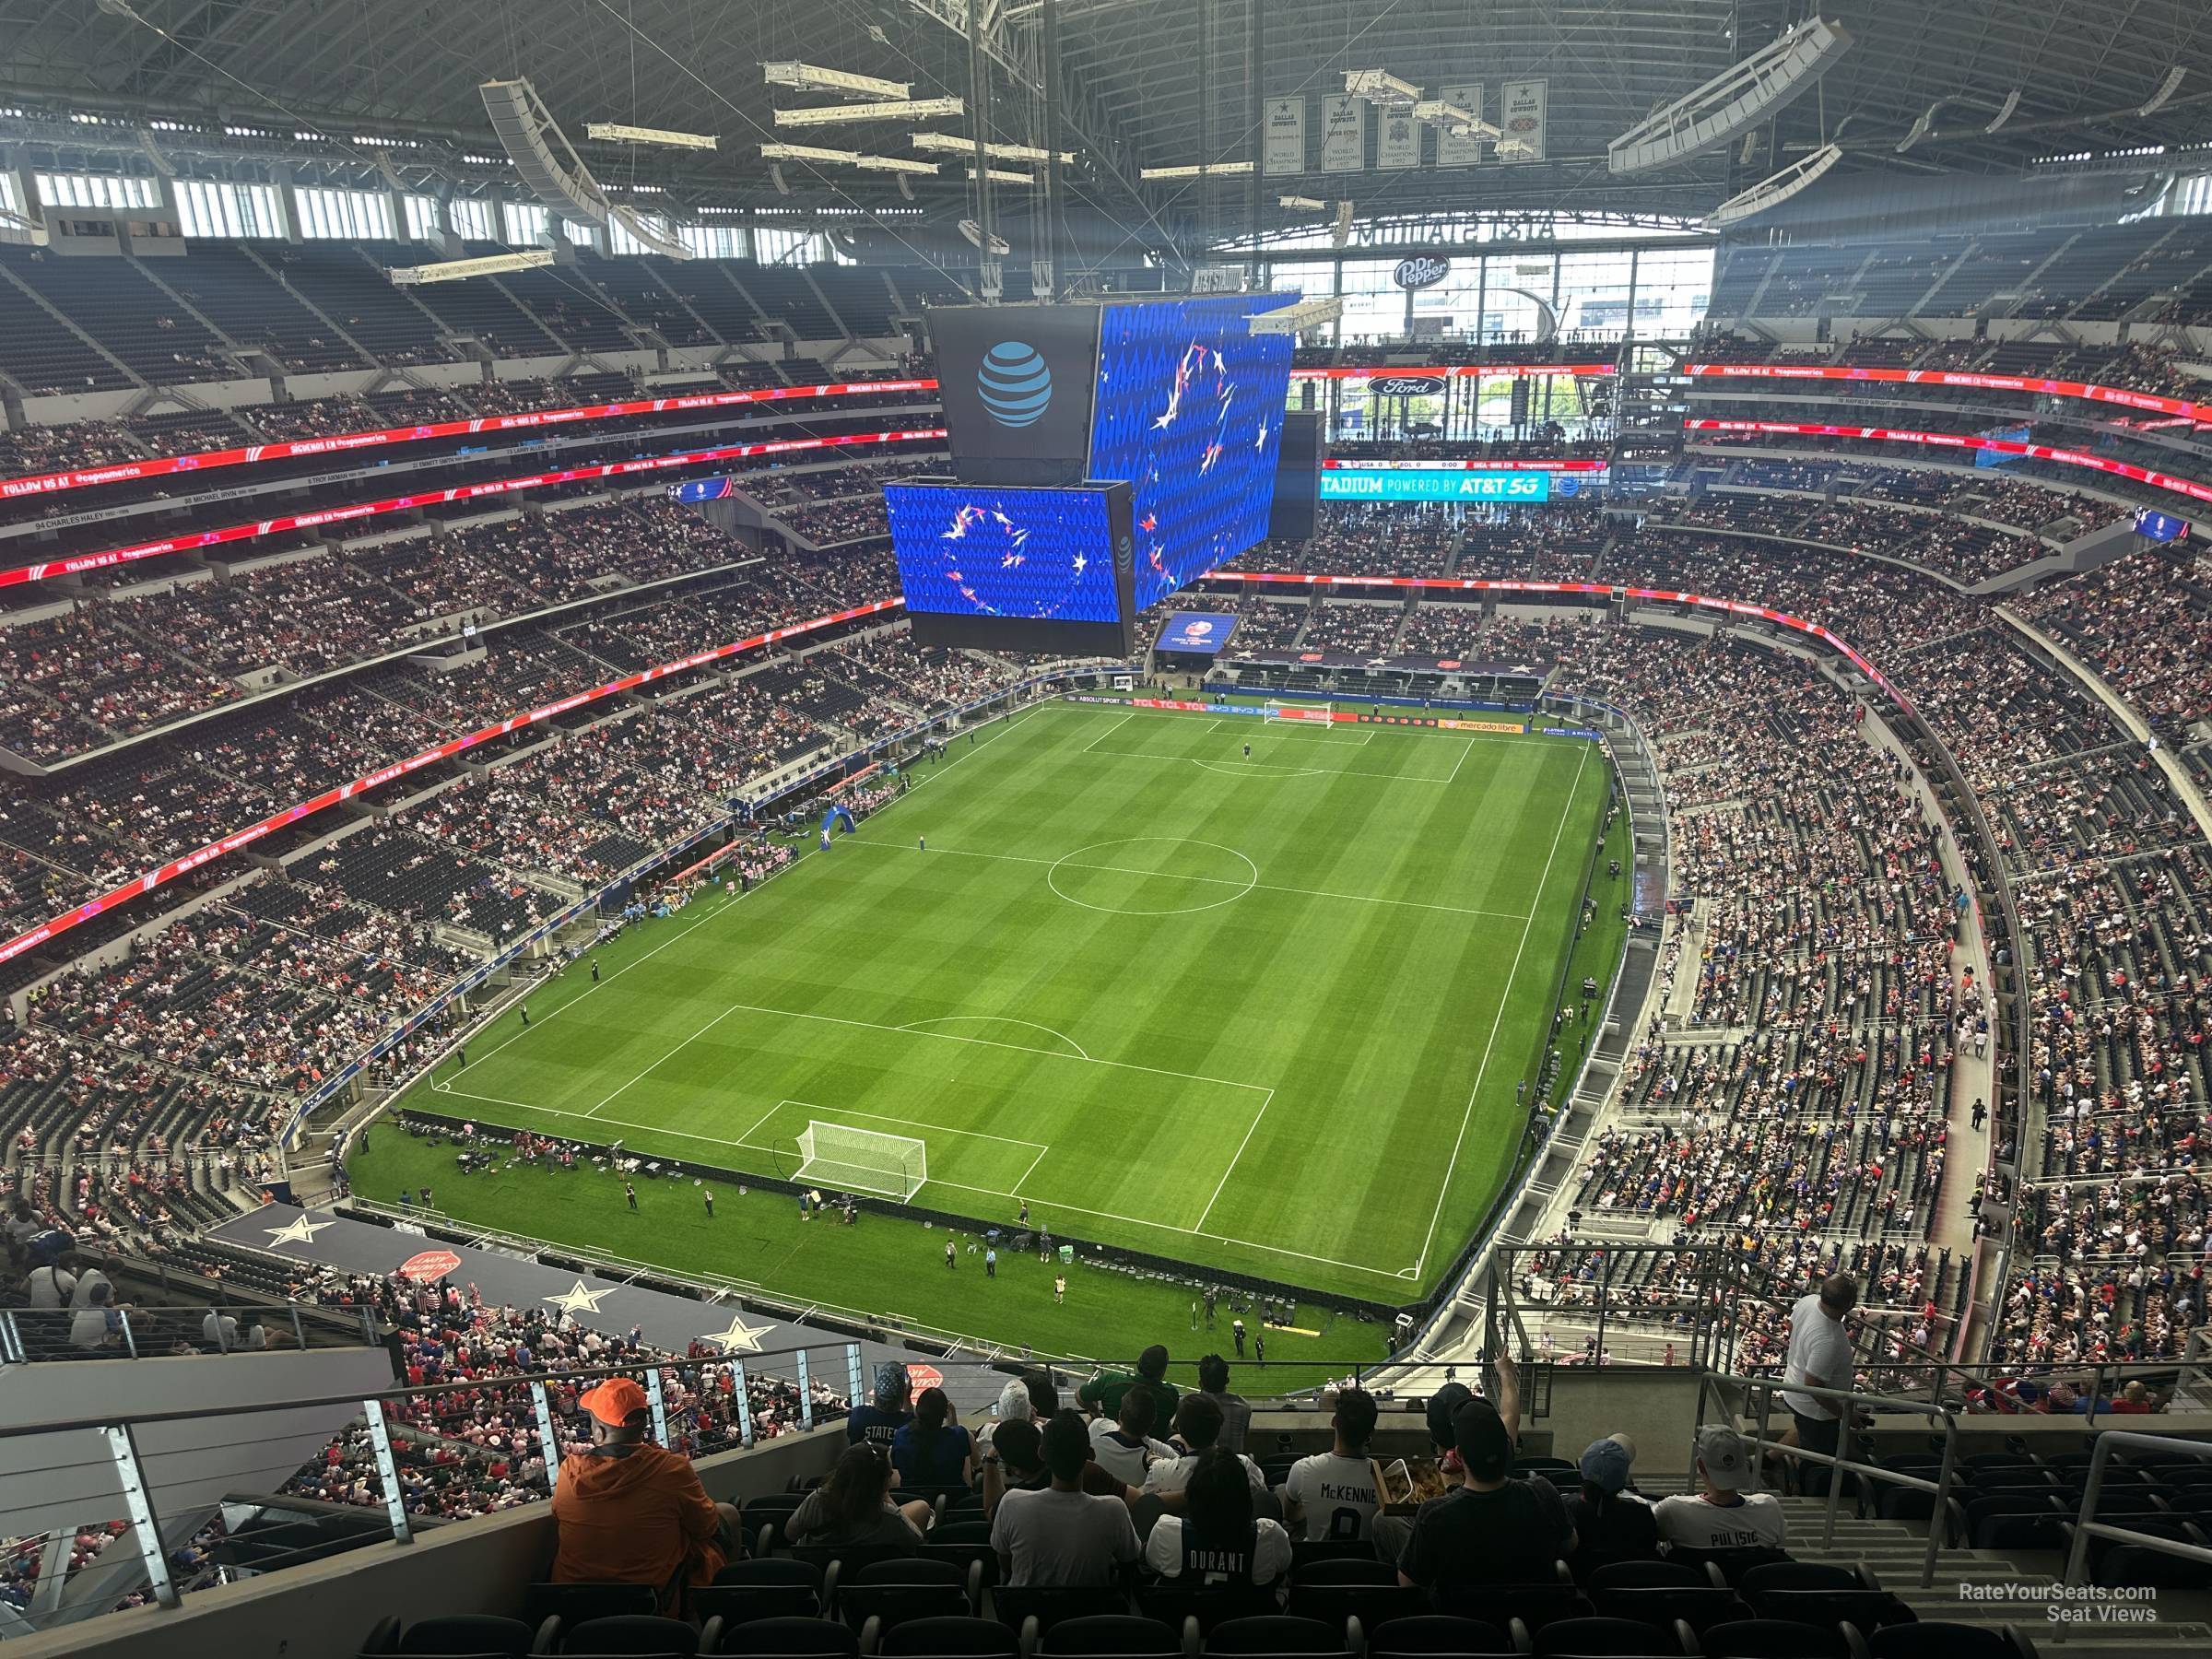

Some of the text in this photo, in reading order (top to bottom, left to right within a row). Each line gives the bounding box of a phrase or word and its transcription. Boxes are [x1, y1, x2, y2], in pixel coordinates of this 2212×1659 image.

[1415, 257, 1434, 273] Dr
[1399, 261, 1446, 286] Pepper
[1382, 378, 1430, 394] Ford
[3, 482, 41, 495] FOLLOW
[44, 479, 56, 488] US
[58, 477, 70, 488] AT
[1321, 477, 1539, 494] TADIUM POWERED BY AT&T 5G
[194, 493, 219, 502] MICHAEL
[35, 522, 45, 530] 94
[46, 517, 80, 528] CHARLES
[81, 512, 104, 523] HALEY
[65, 560, 96, 571] FOLLOW
[97, 557, 108, 565] US
[109, 554, 118, 562] AT
[1135, 699, 1206, 712] TCL TCL TCL
[1460, 720, 1516, 732] mercado libre
[865, 1426, 899, 1440] STATE
[1321, 1482, 1377, 1504] McKENNIE
[1711, 1531, 1759, 1547] PULISIC
[1190, 1550, 1244, 1573] DURANT
